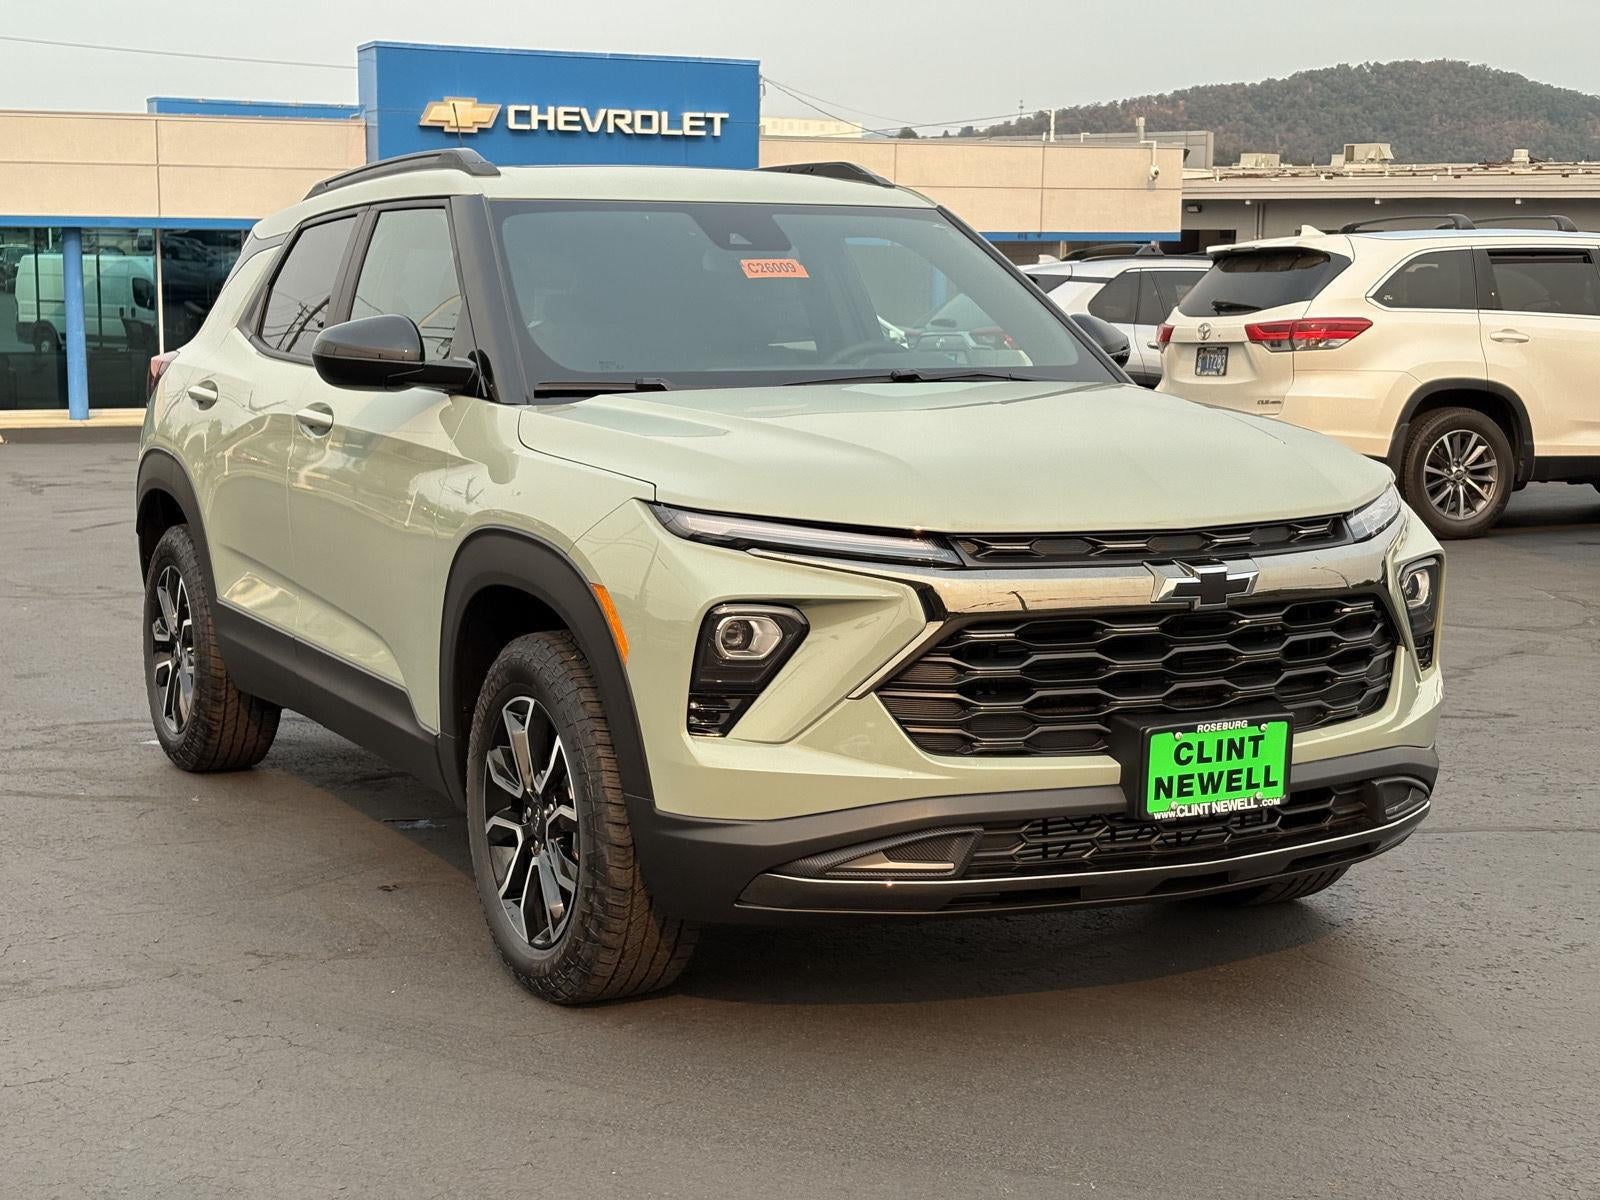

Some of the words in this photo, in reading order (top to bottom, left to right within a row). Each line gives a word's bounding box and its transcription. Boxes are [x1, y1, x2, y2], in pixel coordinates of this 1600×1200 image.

[507, 104, 730, 137] CHEVROLET
[747, 262, 797, 274] C26009
[1197, 720, 1248, 733] ROSEBURG
[1173, 734, 1265, 766] CLINT
[1153, 765, 1278, 801] NEWELL
